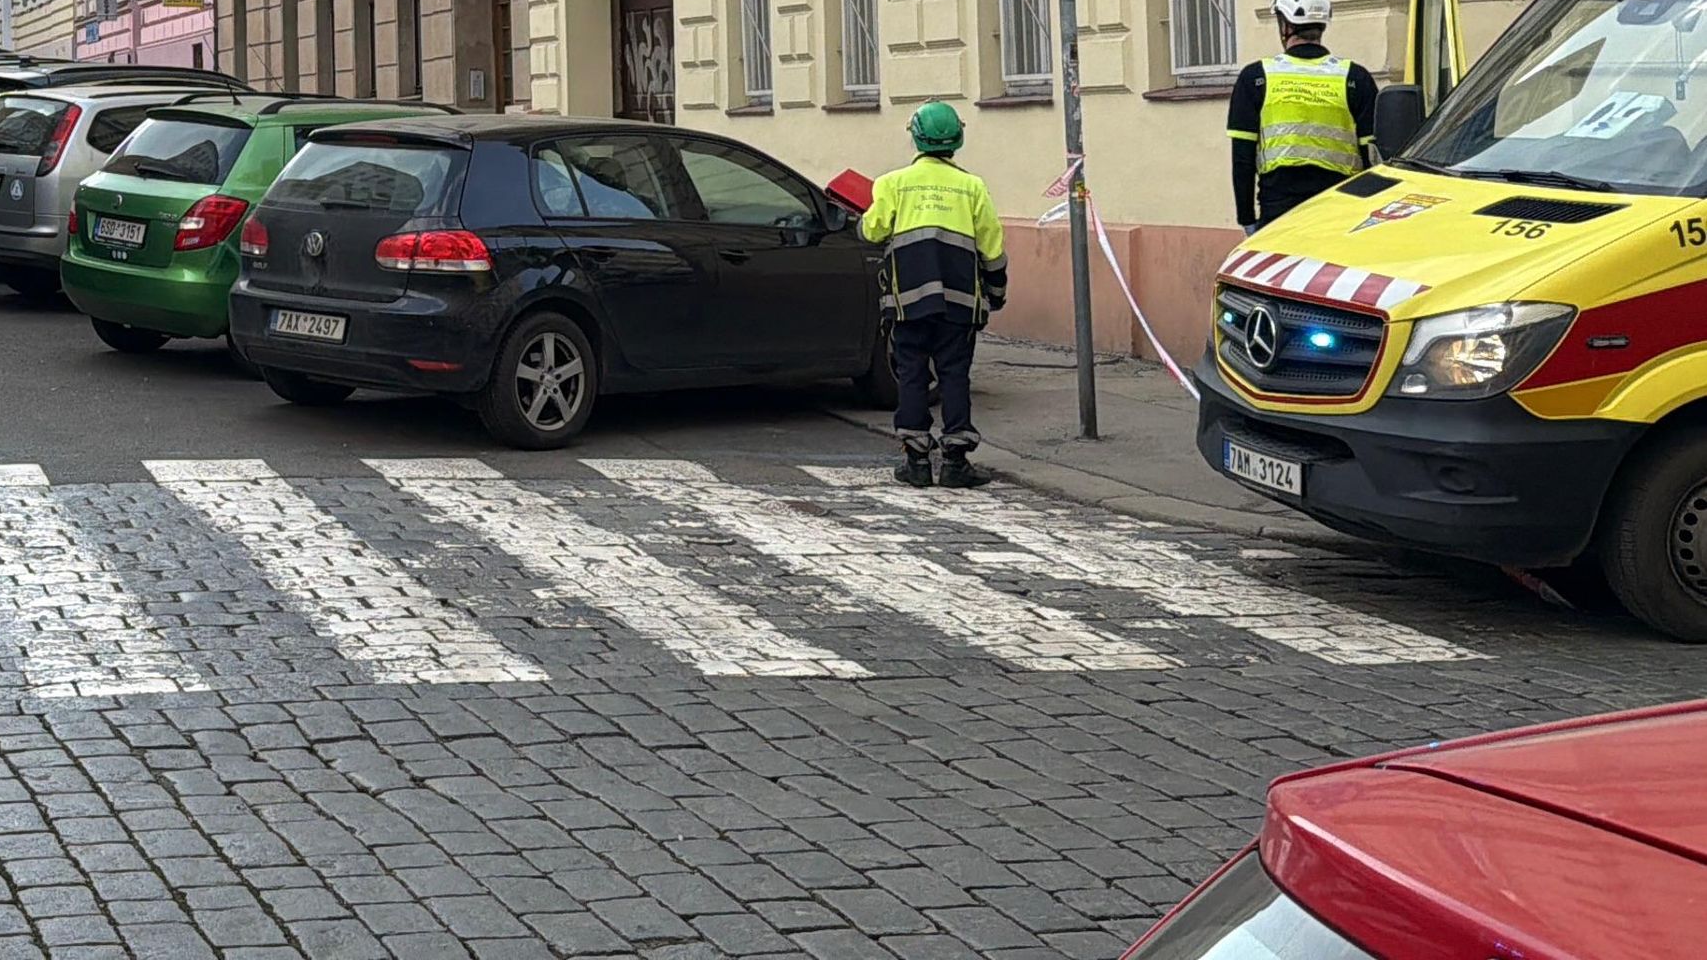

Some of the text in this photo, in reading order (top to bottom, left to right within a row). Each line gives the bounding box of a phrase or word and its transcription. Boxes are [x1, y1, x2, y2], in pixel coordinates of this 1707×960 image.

[120, 223, 141, 241] 3151
[1489, 219, 1552, 240] 156
[278, 312, 340, 336] 7AX 2497
[1231, 446, 1293, 490] 7AM 3124
